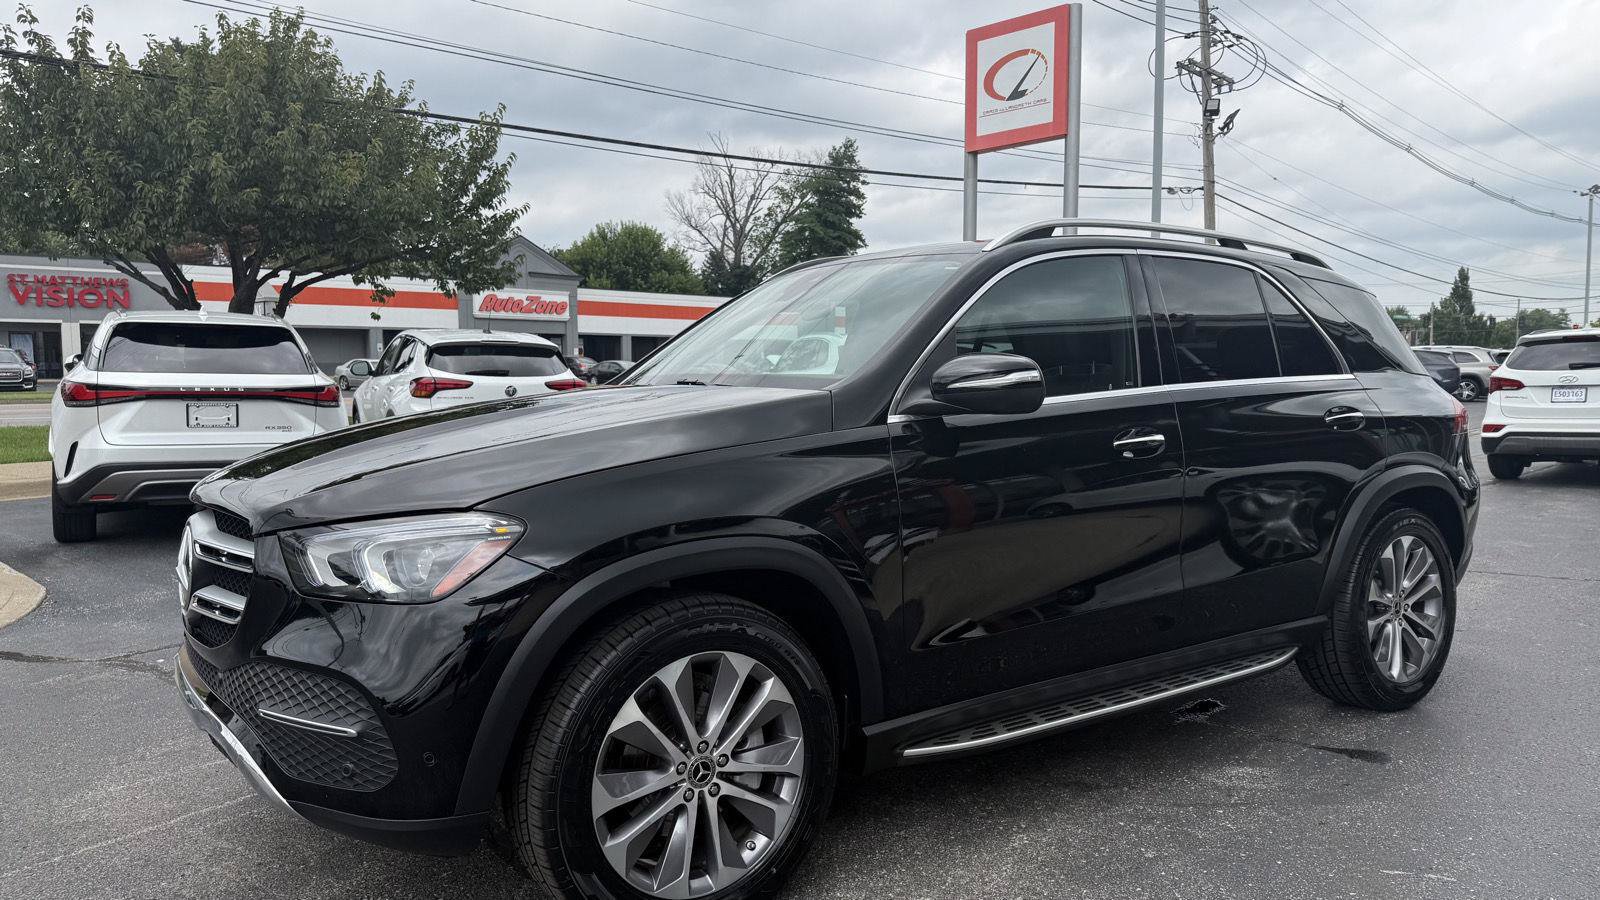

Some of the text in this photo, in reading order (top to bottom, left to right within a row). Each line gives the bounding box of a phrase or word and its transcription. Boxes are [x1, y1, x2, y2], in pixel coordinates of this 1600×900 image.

[34, 274, 129, 289] MATTHEWS
[8, 285, 130, 309] VISION
[478, 293, 568, 315] AutoZone
